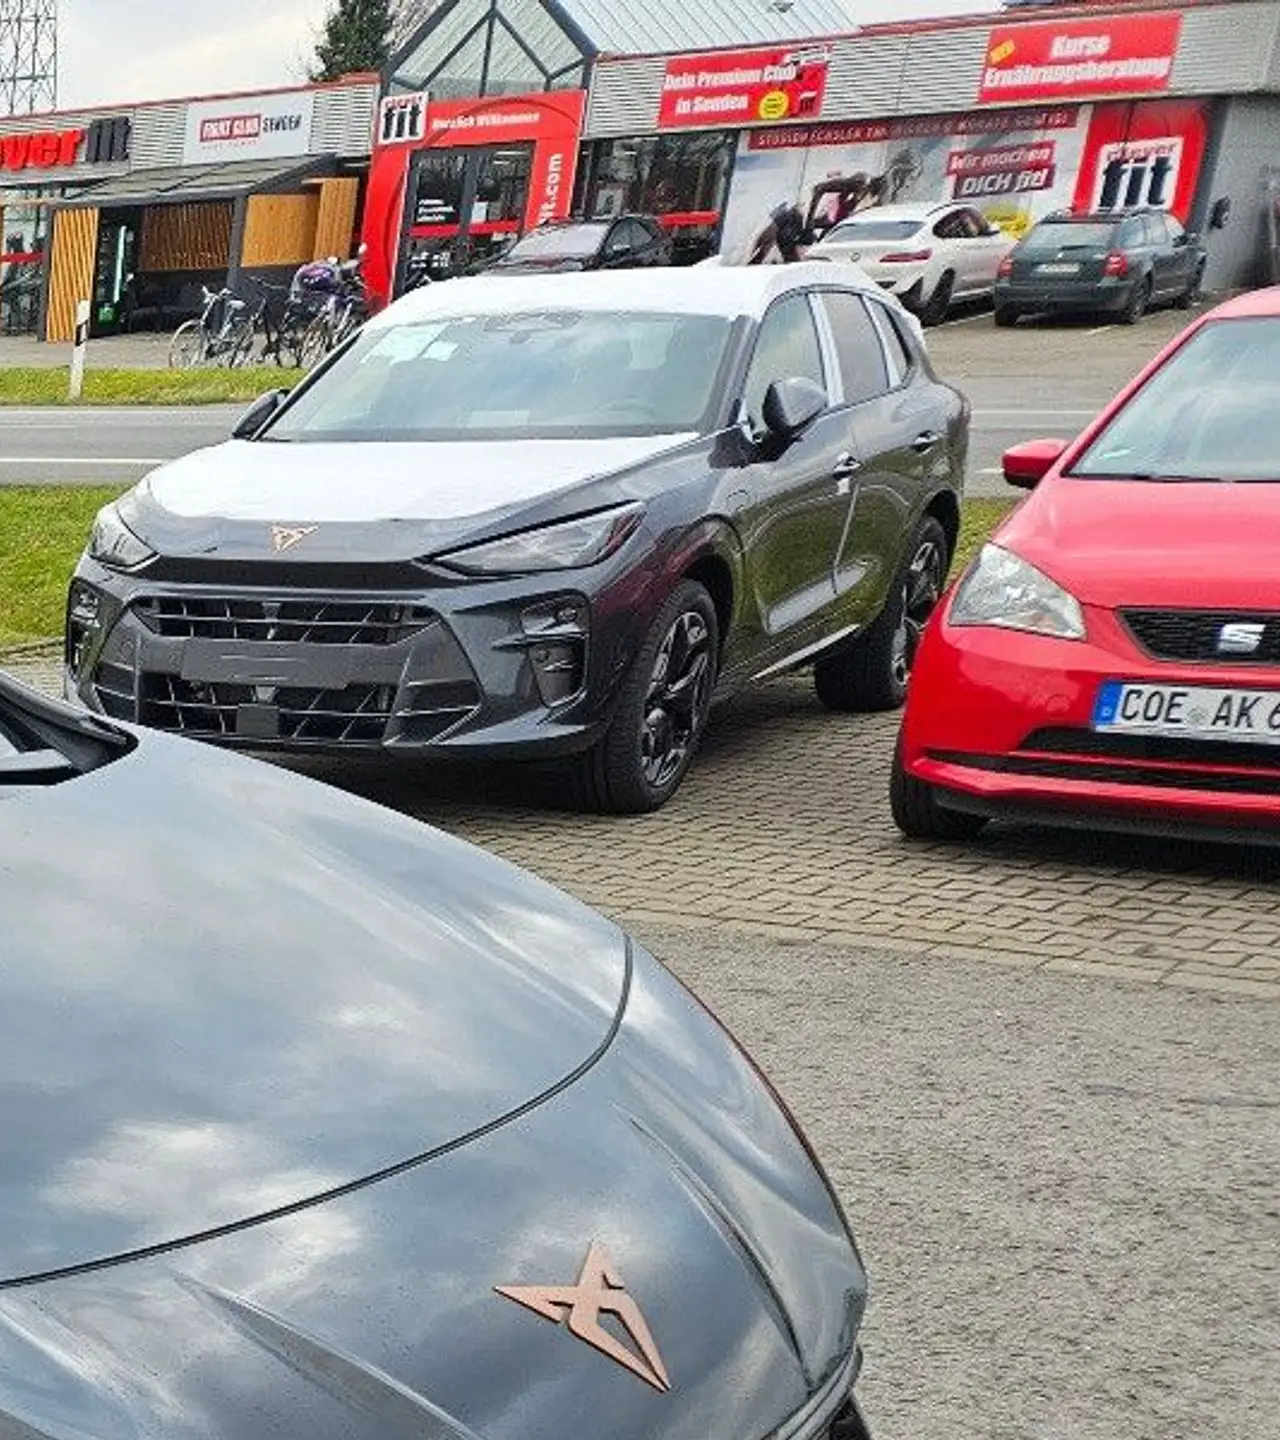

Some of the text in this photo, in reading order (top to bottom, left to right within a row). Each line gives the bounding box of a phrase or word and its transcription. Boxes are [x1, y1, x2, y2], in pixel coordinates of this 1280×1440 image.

[1050, 35, 1112, 59] Kurse
[664, 63, 797, 89] Dein Premium Club
[983, 56, 1172, 88] Ernährungsberatung
[382, 104, 422, 140] fit
[1099, 155, 1173, 208] fit
[1120, 688, 1189, 723] COE
[1211, 695, 1264, 729] AK
